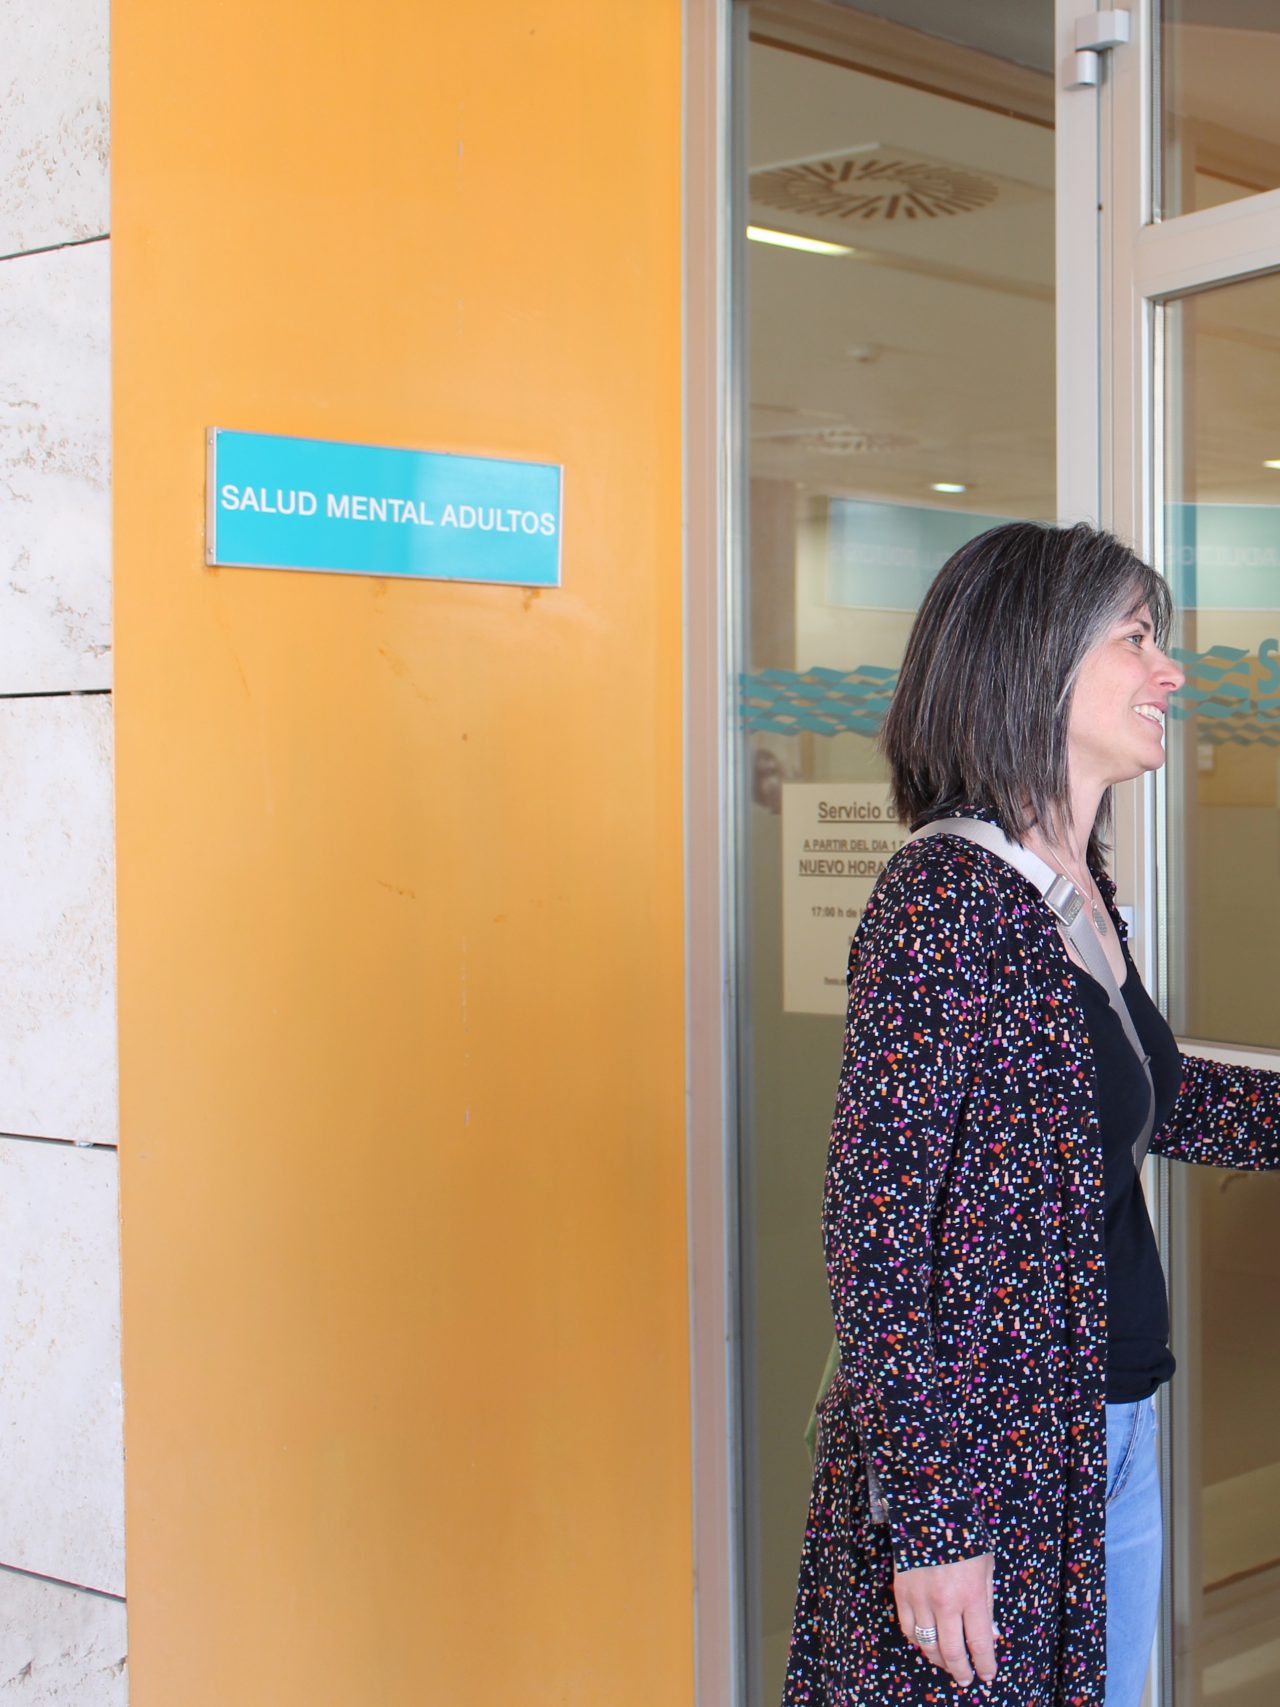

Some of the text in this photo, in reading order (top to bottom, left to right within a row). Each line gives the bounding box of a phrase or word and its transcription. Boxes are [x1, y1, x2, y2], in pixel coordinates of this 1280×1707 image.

[221, 484, 556, 536] SALUD MENTAL ADULTOS
[817, 801, 882, 819] Servicio
[803, 840, 811, 850] A
[813, 840, 848, 850] PARTIR
[850, 840, 869, 850] DEL
[871, 840, 888, 850] DIA
[799, 859, 885, 875] NUEVO HORA
